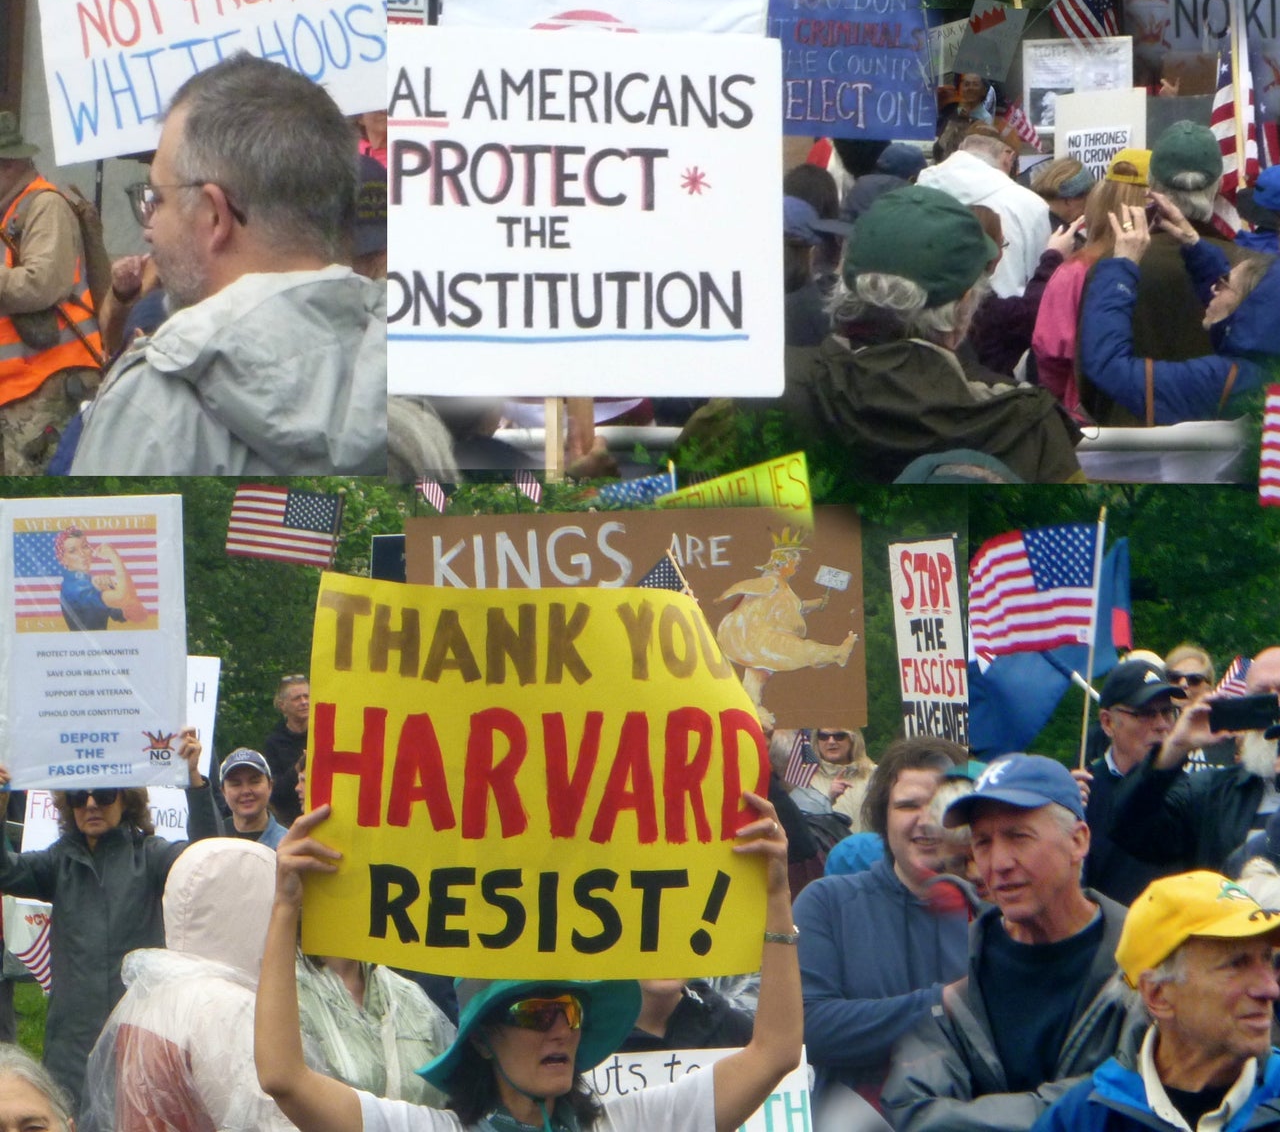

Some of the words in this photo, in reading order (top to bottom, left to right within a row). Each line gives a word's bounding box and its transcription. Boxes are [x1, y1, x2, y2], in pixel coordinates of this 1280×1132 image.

[432, 521, 632, 589] KINGS
[900, 550, 953, 611] STOP
[320, 589, 593, 687] THANK
[910, 618, 947, 652] THE
[60, 732, 119, 744] DEPORT
[76, 749, 104, 759] THE
[311, 702, 770, 845] HARVARD
[368, 864, 732, 956] RESIST!
